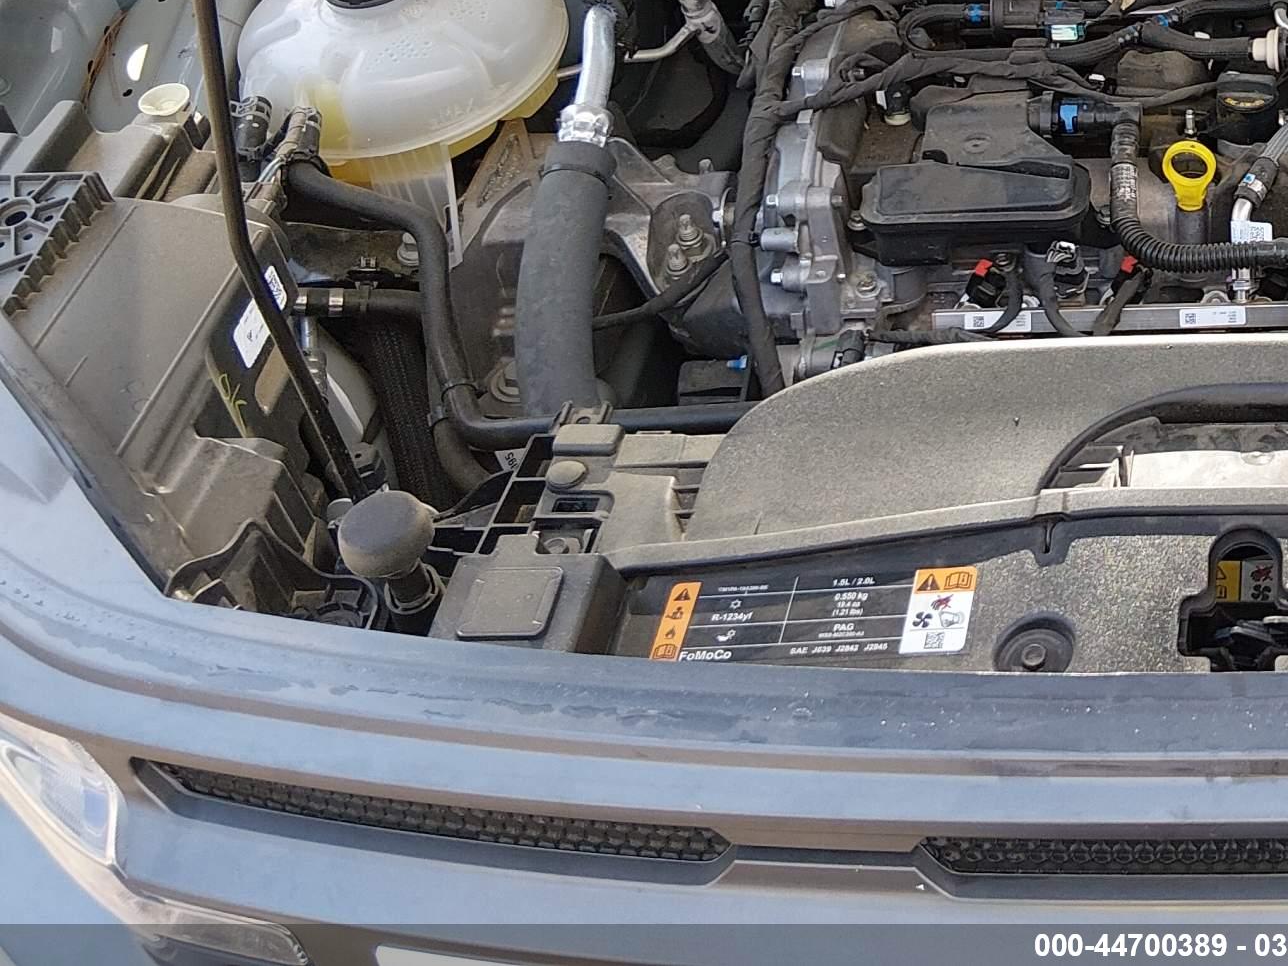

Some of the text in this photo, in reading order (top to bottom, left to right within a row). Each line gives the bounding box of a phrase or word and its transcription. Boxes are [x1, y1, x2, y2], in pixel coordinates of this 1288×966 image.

[857, 576, 875, 585] 2.0L
[834, 591, 869, 601] 0.550 kg
[711, 611, 753, 622] R-1234yf
[833, 622, 855, 632] PAG
[678, 649, 732, 662] FoMoCo
[789, 646, 809, 655] SAE
